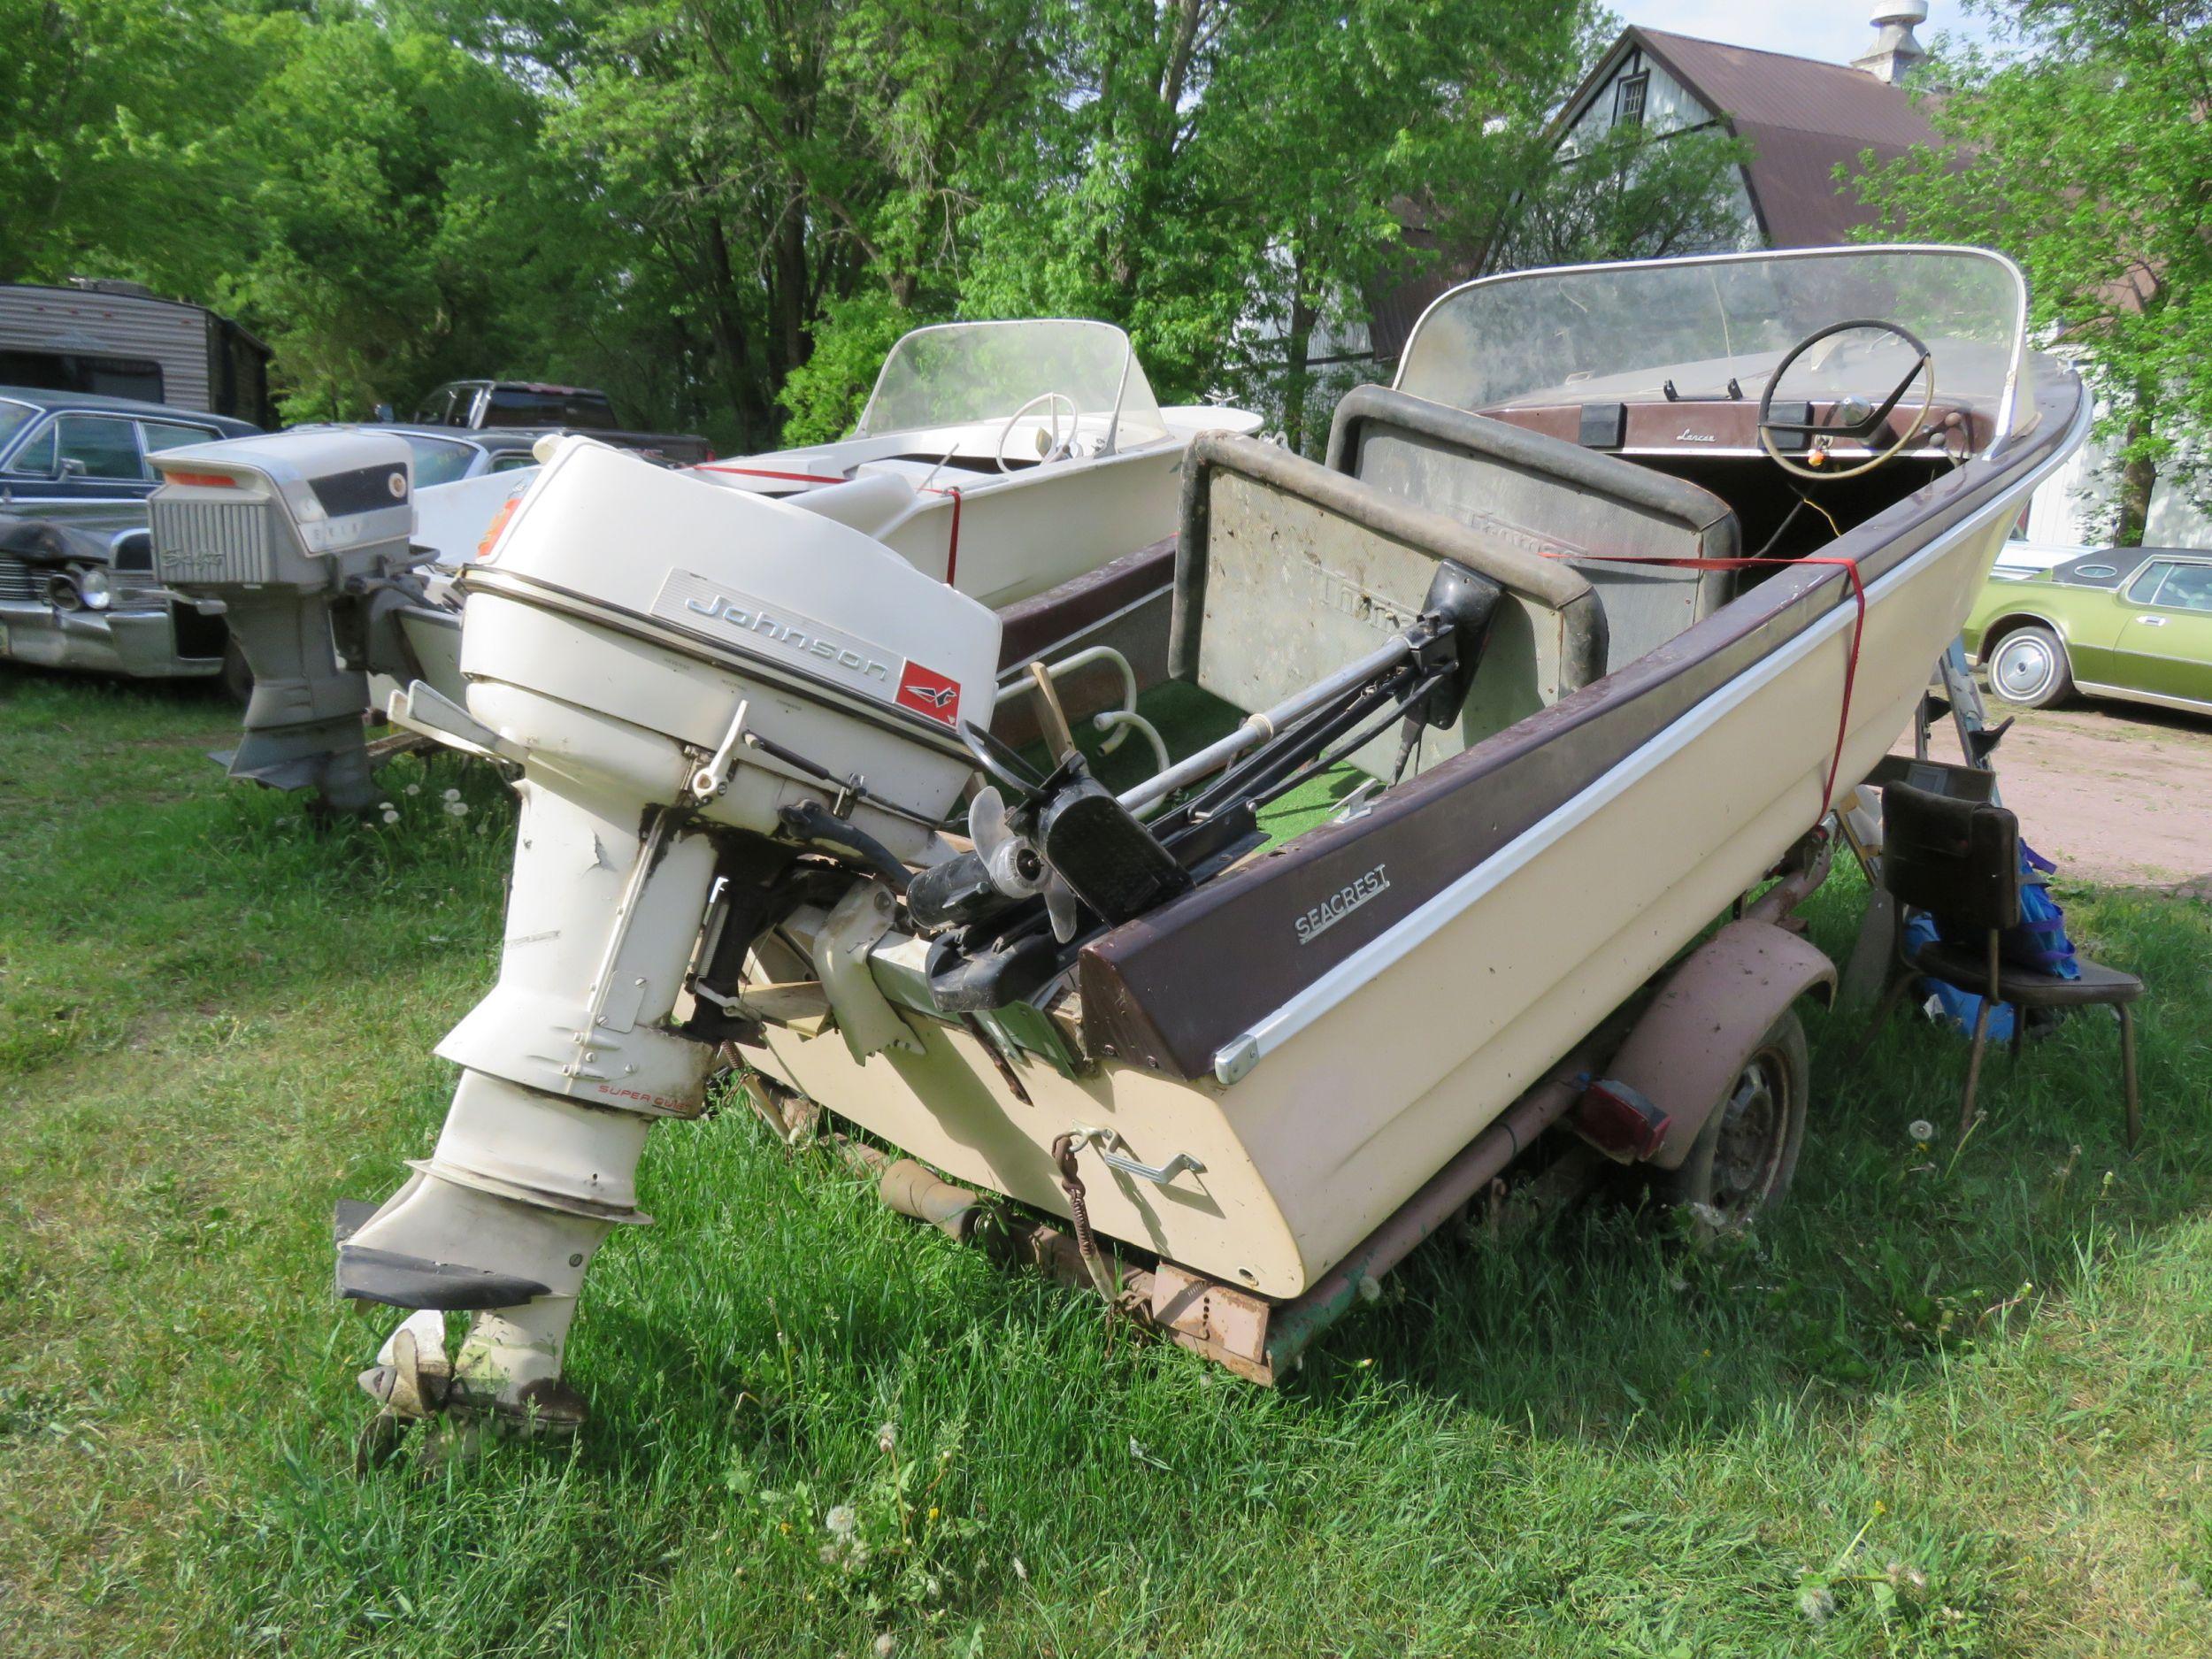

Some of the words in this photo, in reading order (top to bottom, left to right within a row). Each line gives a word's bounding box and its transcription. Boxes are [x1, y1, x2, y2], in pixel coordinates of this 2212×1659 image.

[685, 595, 889, 680] Johnson
[1294, 864, 1390, 944] SEACREST
[598, 1085, 652, 1103] SUPER
[653, 1096, 689, 1111] QUIE
